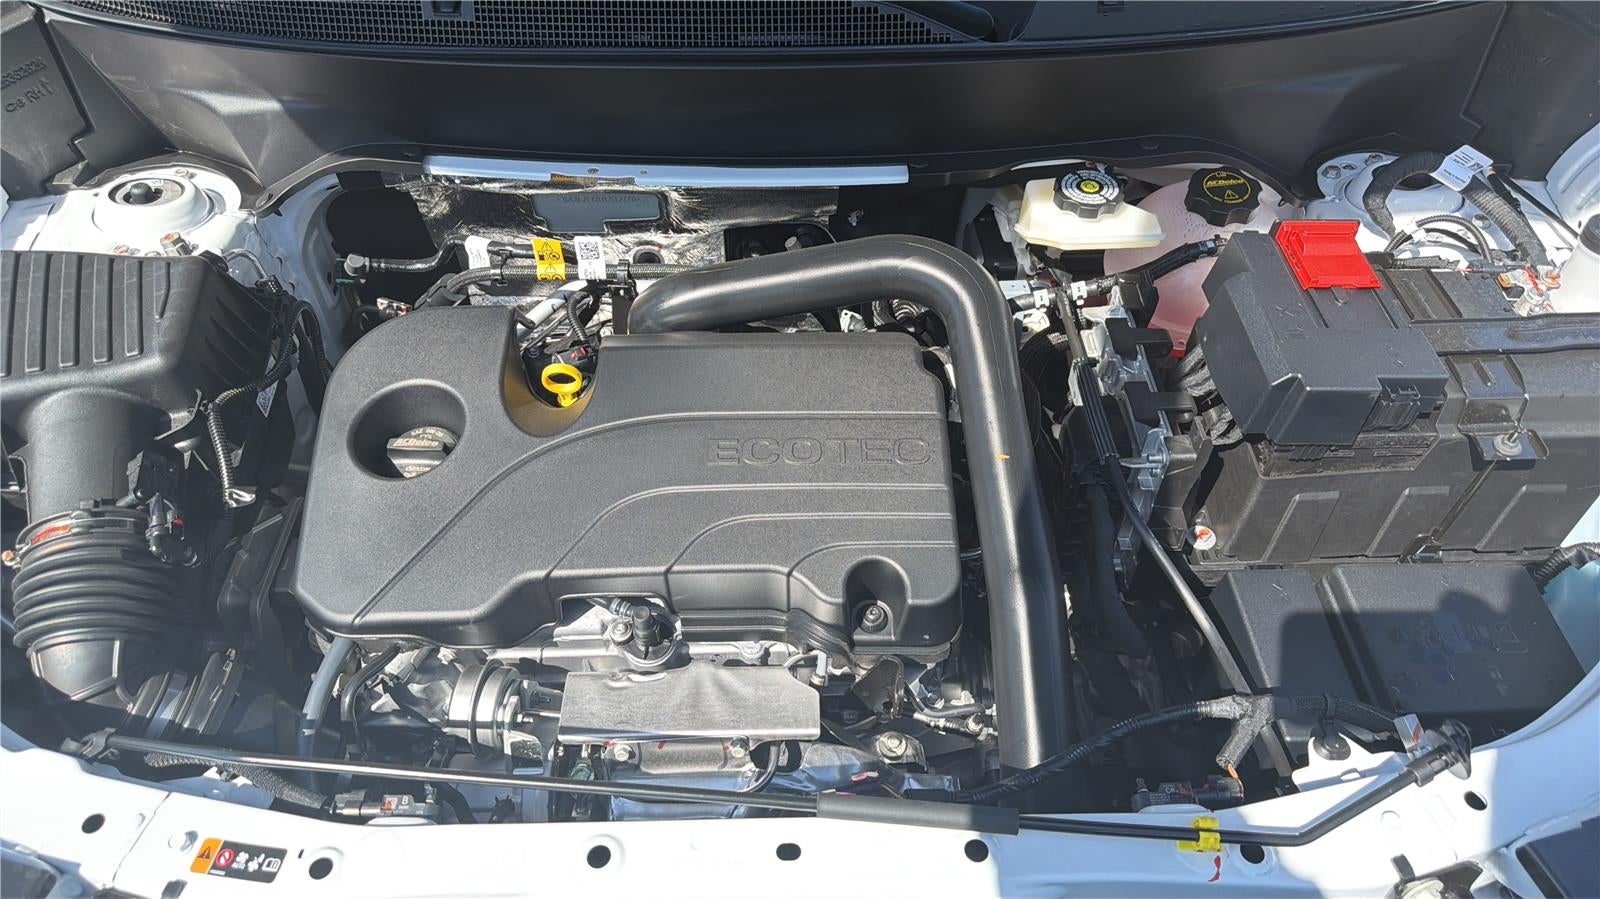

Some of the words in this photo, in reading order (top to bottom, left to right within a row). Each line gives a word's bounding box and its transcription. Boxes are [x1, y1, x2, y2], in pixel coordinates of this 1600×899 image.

[1206, 179, 1245, 187] ACDelco
[393, 439, 439, 447] ACDelco
[706, 437, 931, 465] ECOTEC
